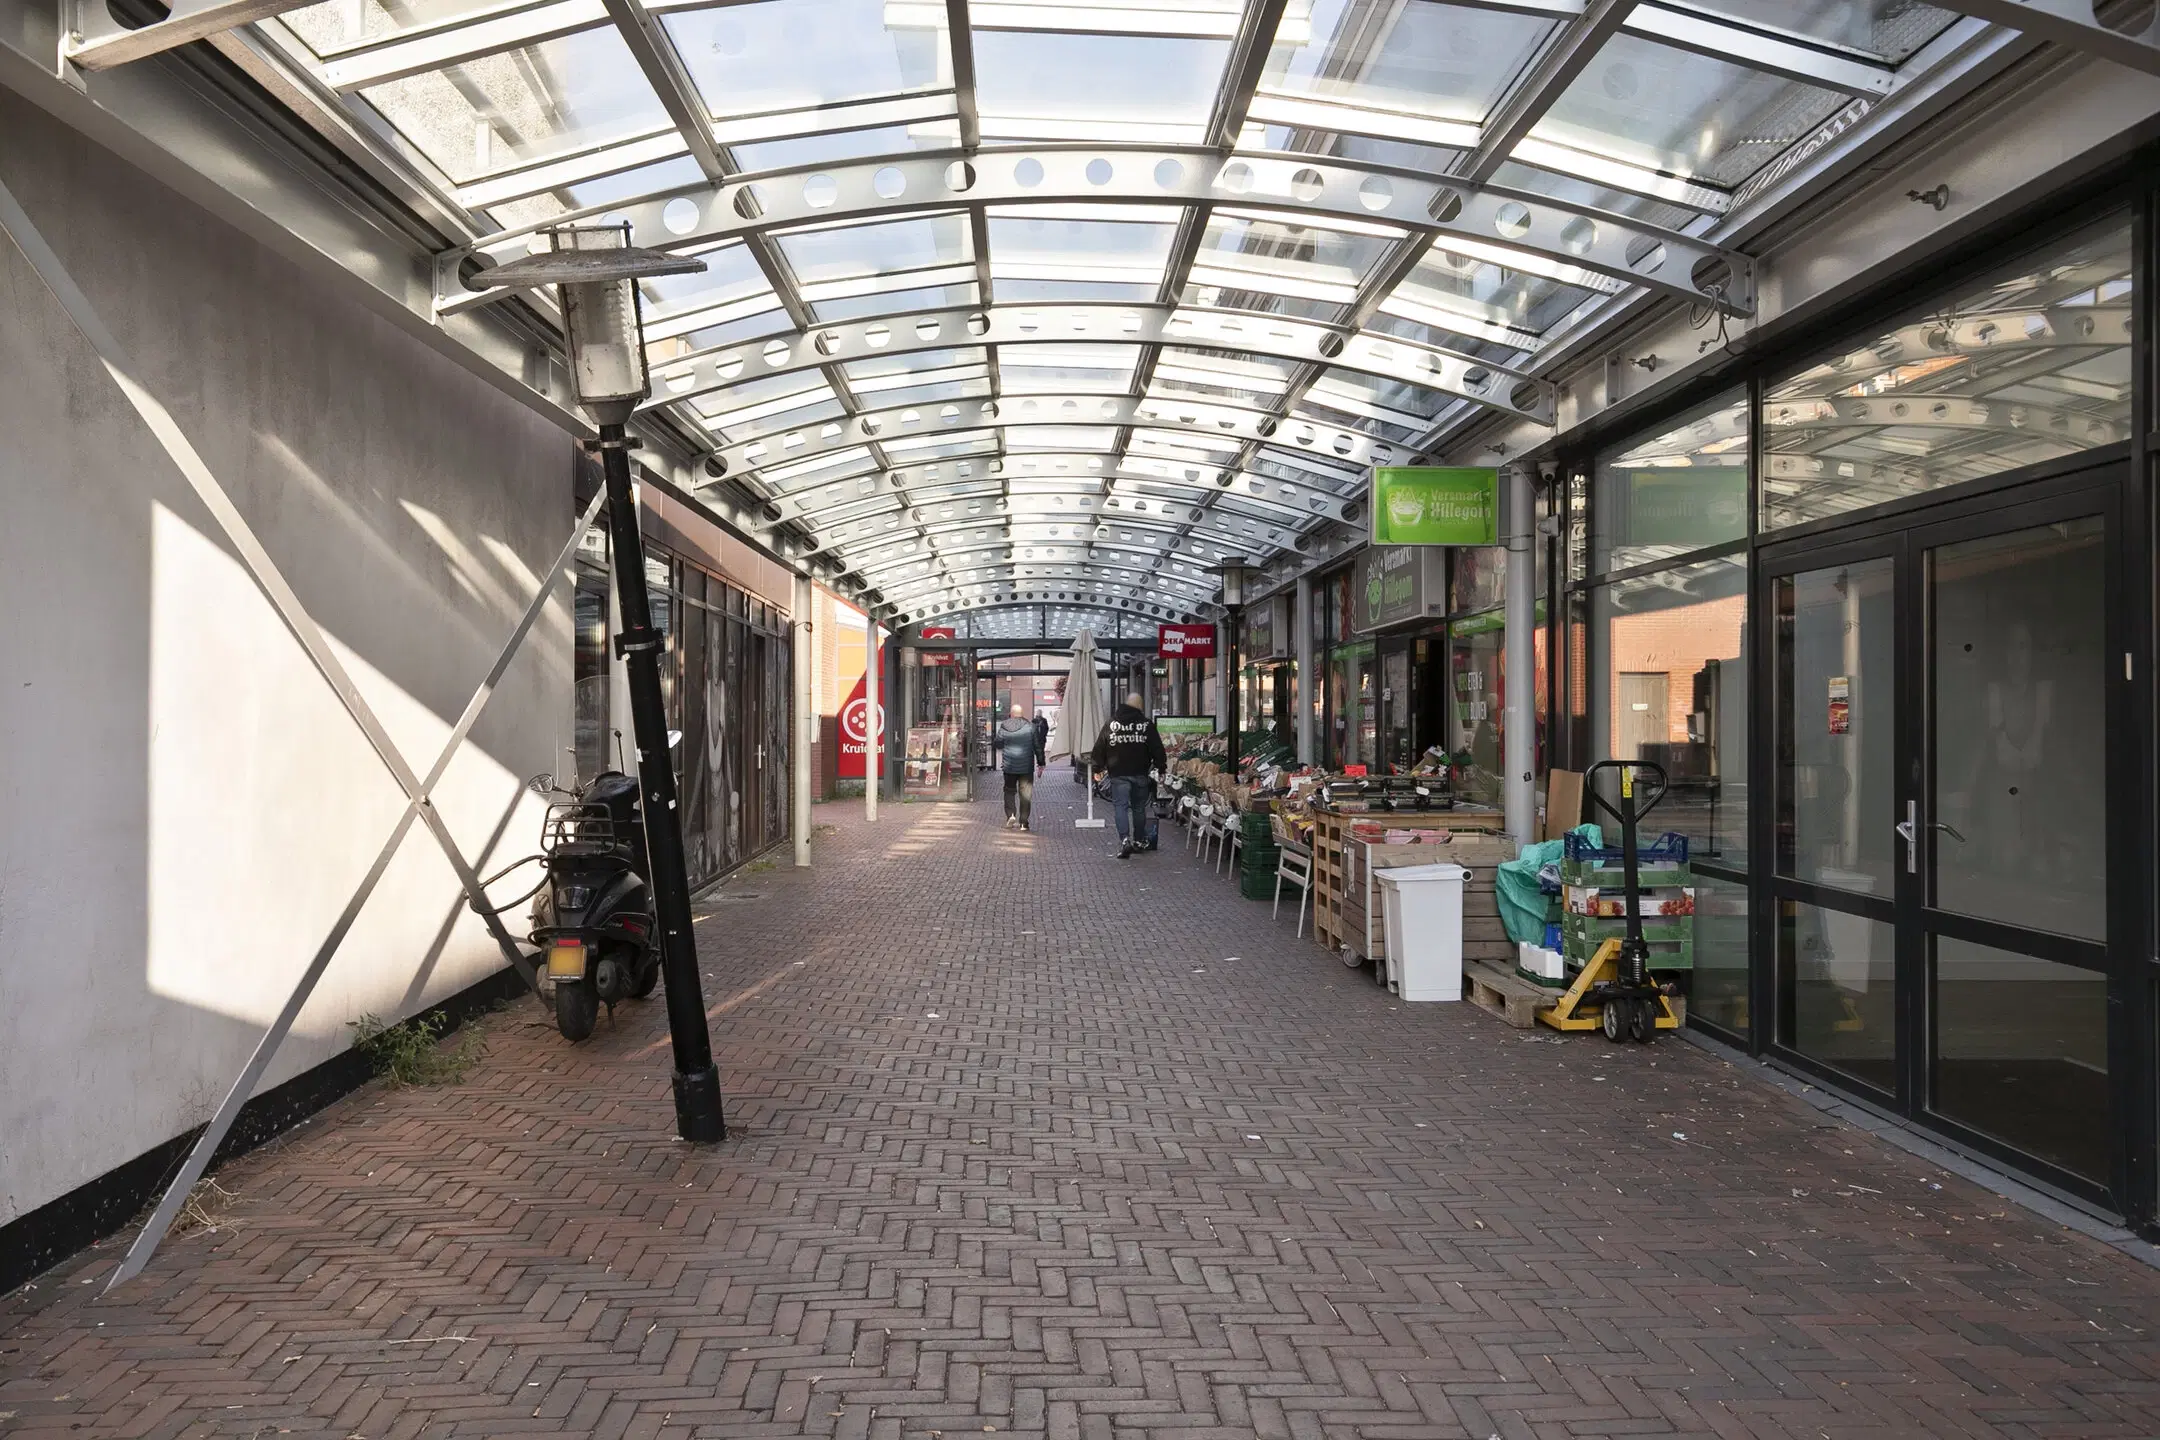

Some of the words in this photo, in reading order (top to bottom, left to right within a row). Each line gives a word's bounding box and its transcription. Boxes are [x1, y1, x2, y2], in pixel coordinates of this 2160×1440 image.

[1430, 502, 1491, 520] Hillegom
[1163, 637, 1212, 645] DEKAMARKT
[1109, 720, 1134, 733] Out
[1136, 721, 1149, 733] of
[842, 743, 885, 754] Kruiat
